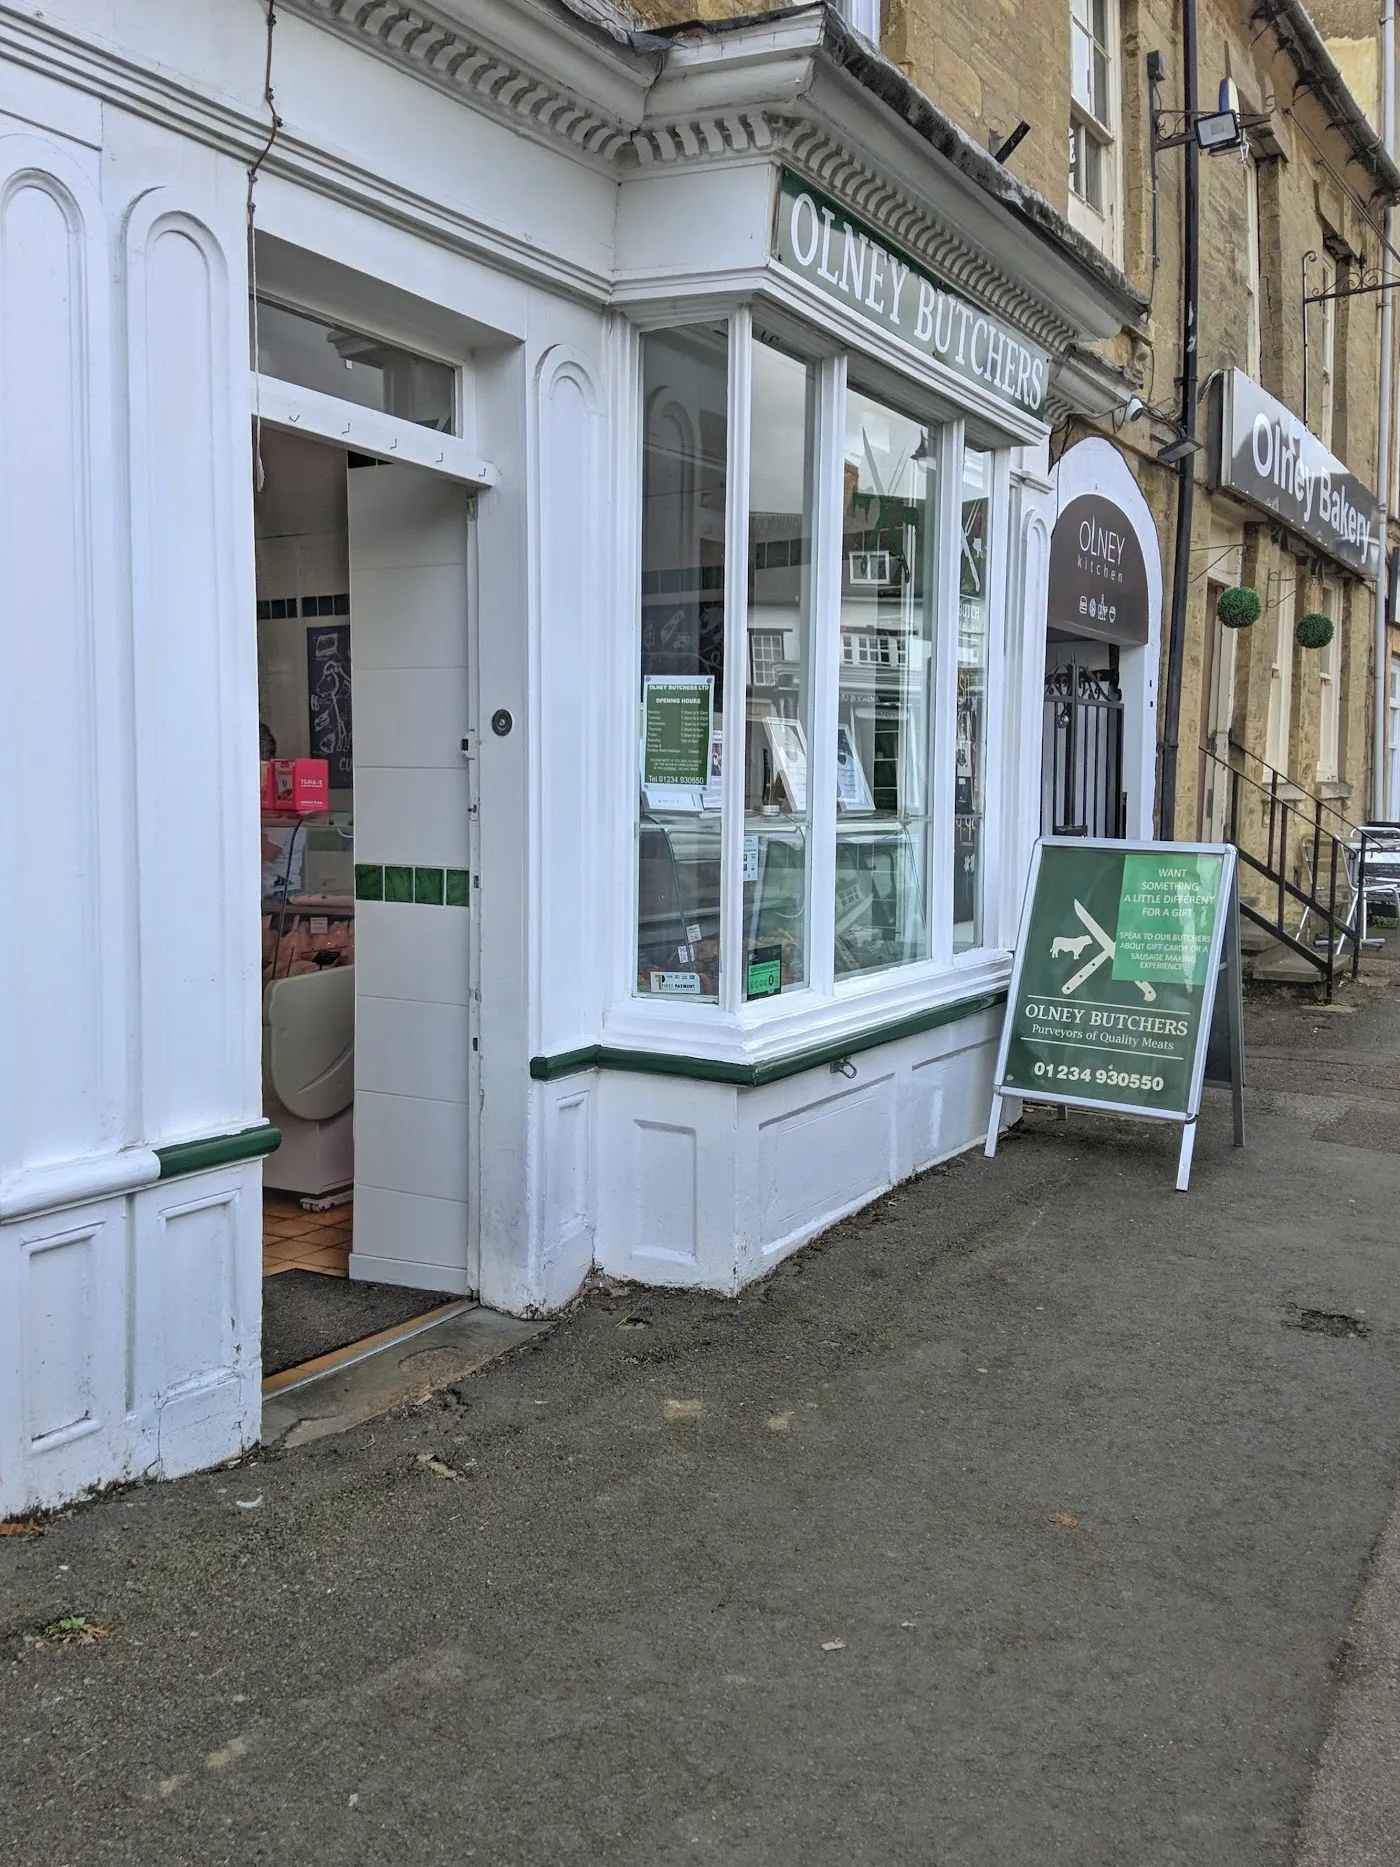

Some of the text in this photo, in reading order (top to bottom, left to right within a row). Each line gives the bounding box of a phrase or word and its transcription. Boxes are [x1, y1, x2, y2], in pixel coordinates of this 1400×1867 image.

[790, 193, 1044, 410] OLNEY BUTCHERS
[1252, 413, 1371, 565] Olney Bakery
[1079, 517, 1126, 566] OLNEY
[1077, 555, 1124, 584] kitchen
[648, 774, 704, 784] Tel 01234 930550
[1158, 868, 1188, 877] WANT
[1141, 881, 1200, 891] SOMETHING
[1123, 894, 1215, 905] A LITTLE DIFFERENT
[1142, 907, 1194, 918] FOR A GIFT
[1119, 931, 1212, 943] SPEAK TO OUR BUTCHERS
[1119, 942, 1209, 953] ABOUT GIFT CARDS OR A
[1130, 952, 1197, 963] SAUSAGE MAKING
[1139, 961, 1183, 970] EXPERIENCE
[1025, 1003, 1188, 1036] OLNEY BUTCHERS
[1031, 1023, 1175, 1050] Purveyors of Quality Meats
[1034, 1061, 1165, 1091] 01234 930550
